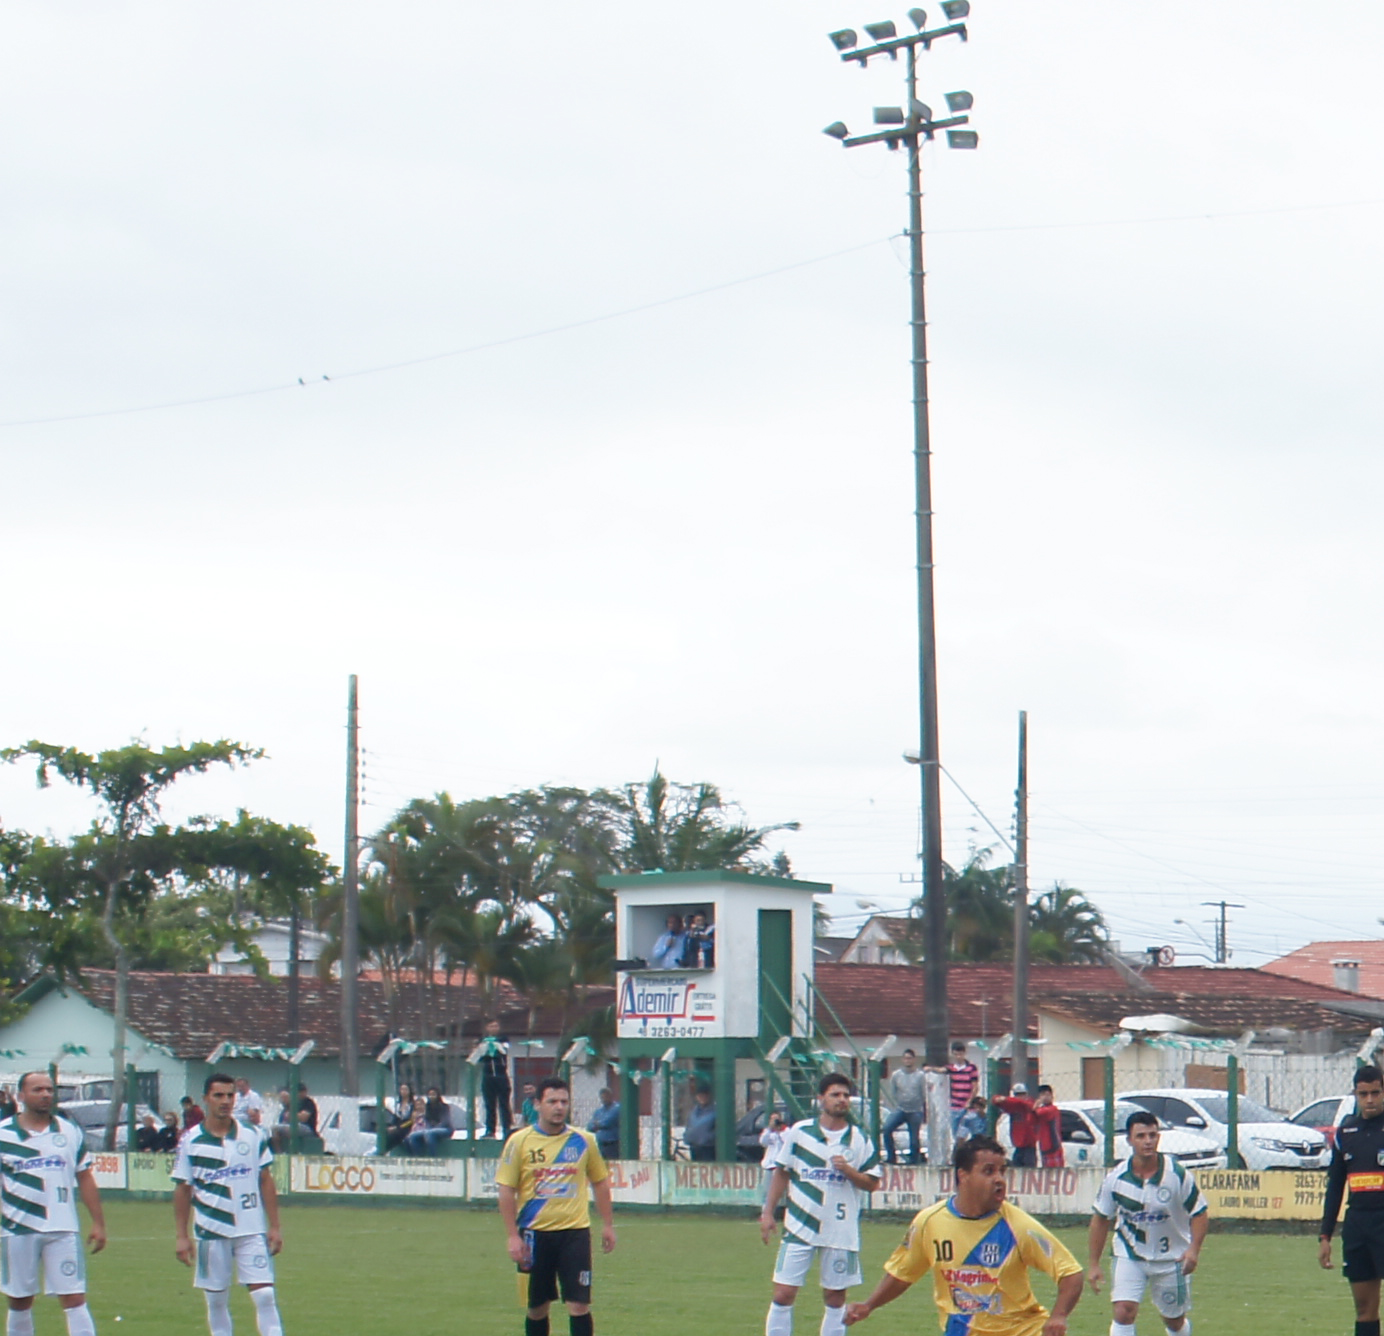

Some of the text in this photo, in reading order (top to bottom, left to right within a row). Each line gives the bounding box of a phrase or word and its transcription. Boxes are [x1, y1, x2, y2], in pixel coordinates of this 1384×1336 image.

[651, 1027, 705, 1037] 3263-0477
[306, 1165, 375, 1191] LOCCO
[675, 1165, 755, 1189] MERCADO
[1201, 1174, 1261, 1191] CLARAFARM
[241, 1193, 257, 1209] 20
[836, 1203, 847, 1220] 5
[933, 1239, 953, 1262] 10
[1159, 1236, 1169, 1253] 3
